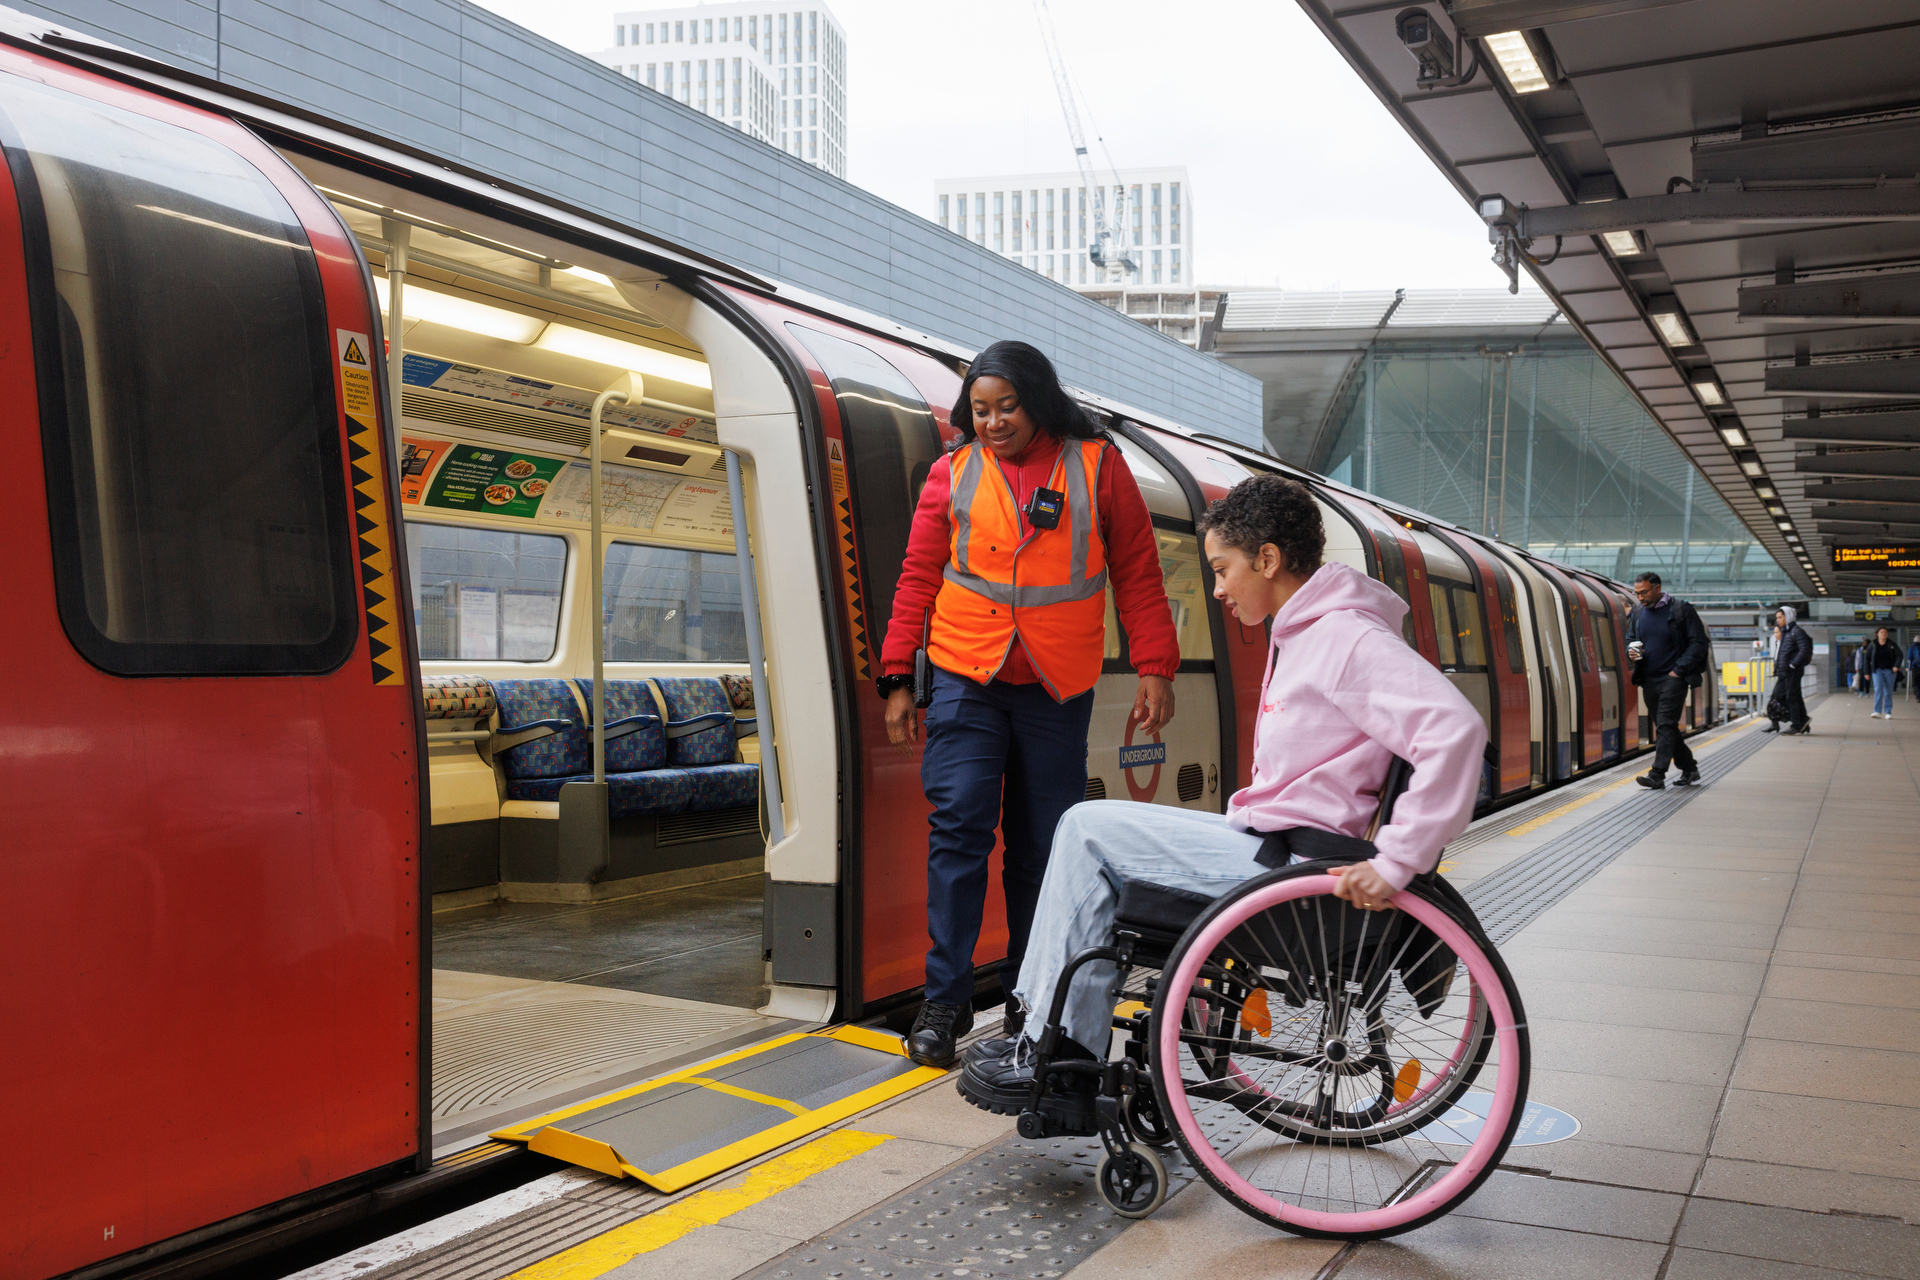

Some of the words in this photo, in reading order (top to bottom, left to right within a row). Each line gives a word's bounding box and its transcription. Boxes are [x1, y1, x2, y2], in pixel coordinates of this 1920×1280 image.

[344, 370, 369, 381] Caution
[345, 381, 370, 390] Obstructing
[346, 392, 367, 401] dangerous
[684, 484, 697, 493] Long
[696, 486, 719, 495] Exposure
[1121, 747, 1164, 764] UNDERGROUND
[1518, 1114, 1538, 1129] access
[1535, 1117, 1558, 1136] stations
[104, 1225, 115, 1241] H
